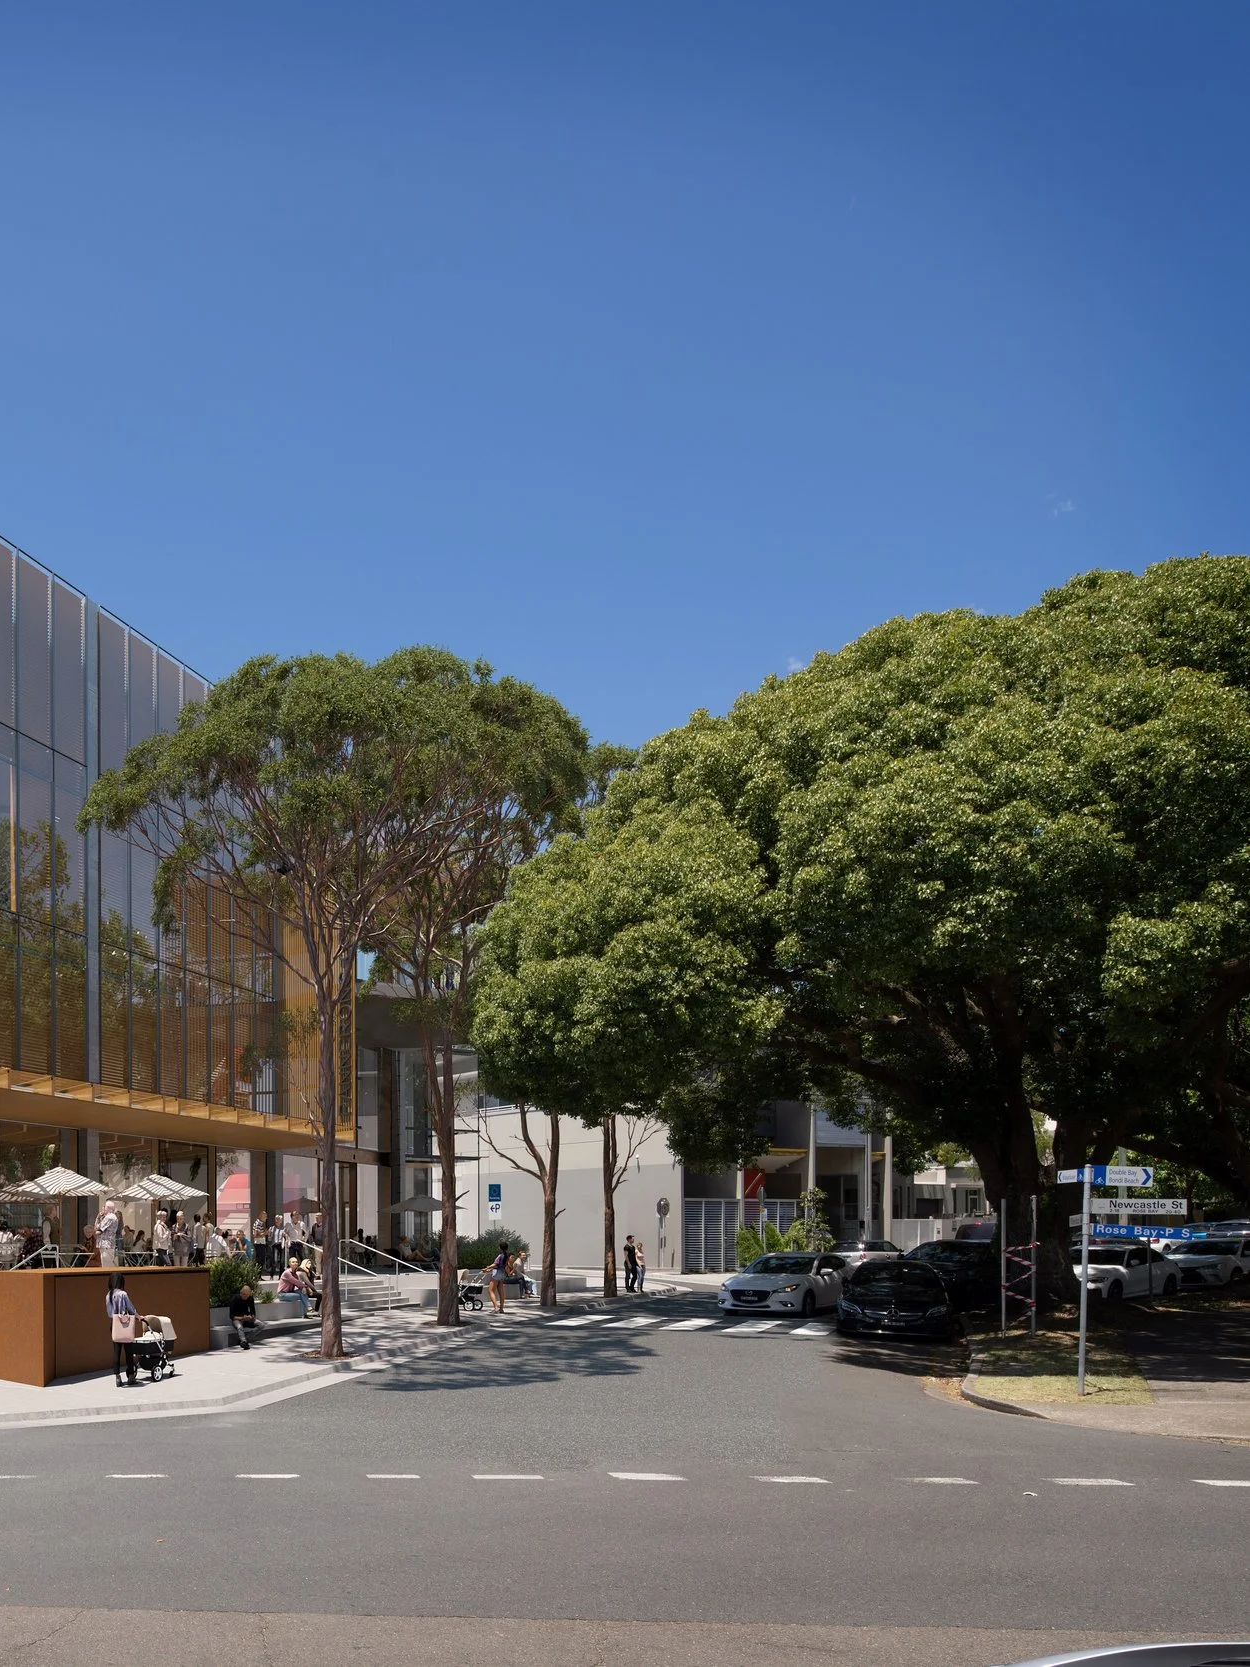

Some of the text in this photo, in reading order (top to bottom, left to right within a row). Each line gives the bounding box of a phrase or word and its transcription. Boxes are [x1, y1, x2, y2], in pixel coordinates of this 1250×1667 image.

[1109, 1167, 1137, 1177] Double Bay
[1109, 1176, 1124, 1184] Bondi
[495, 1203, 501, 1213] P
[1109, 1200, 1183, 1210] Newcastle St
[1096, 1225, 1127, 1235] Rose
[1181, 1228, 1190, 1238] S
